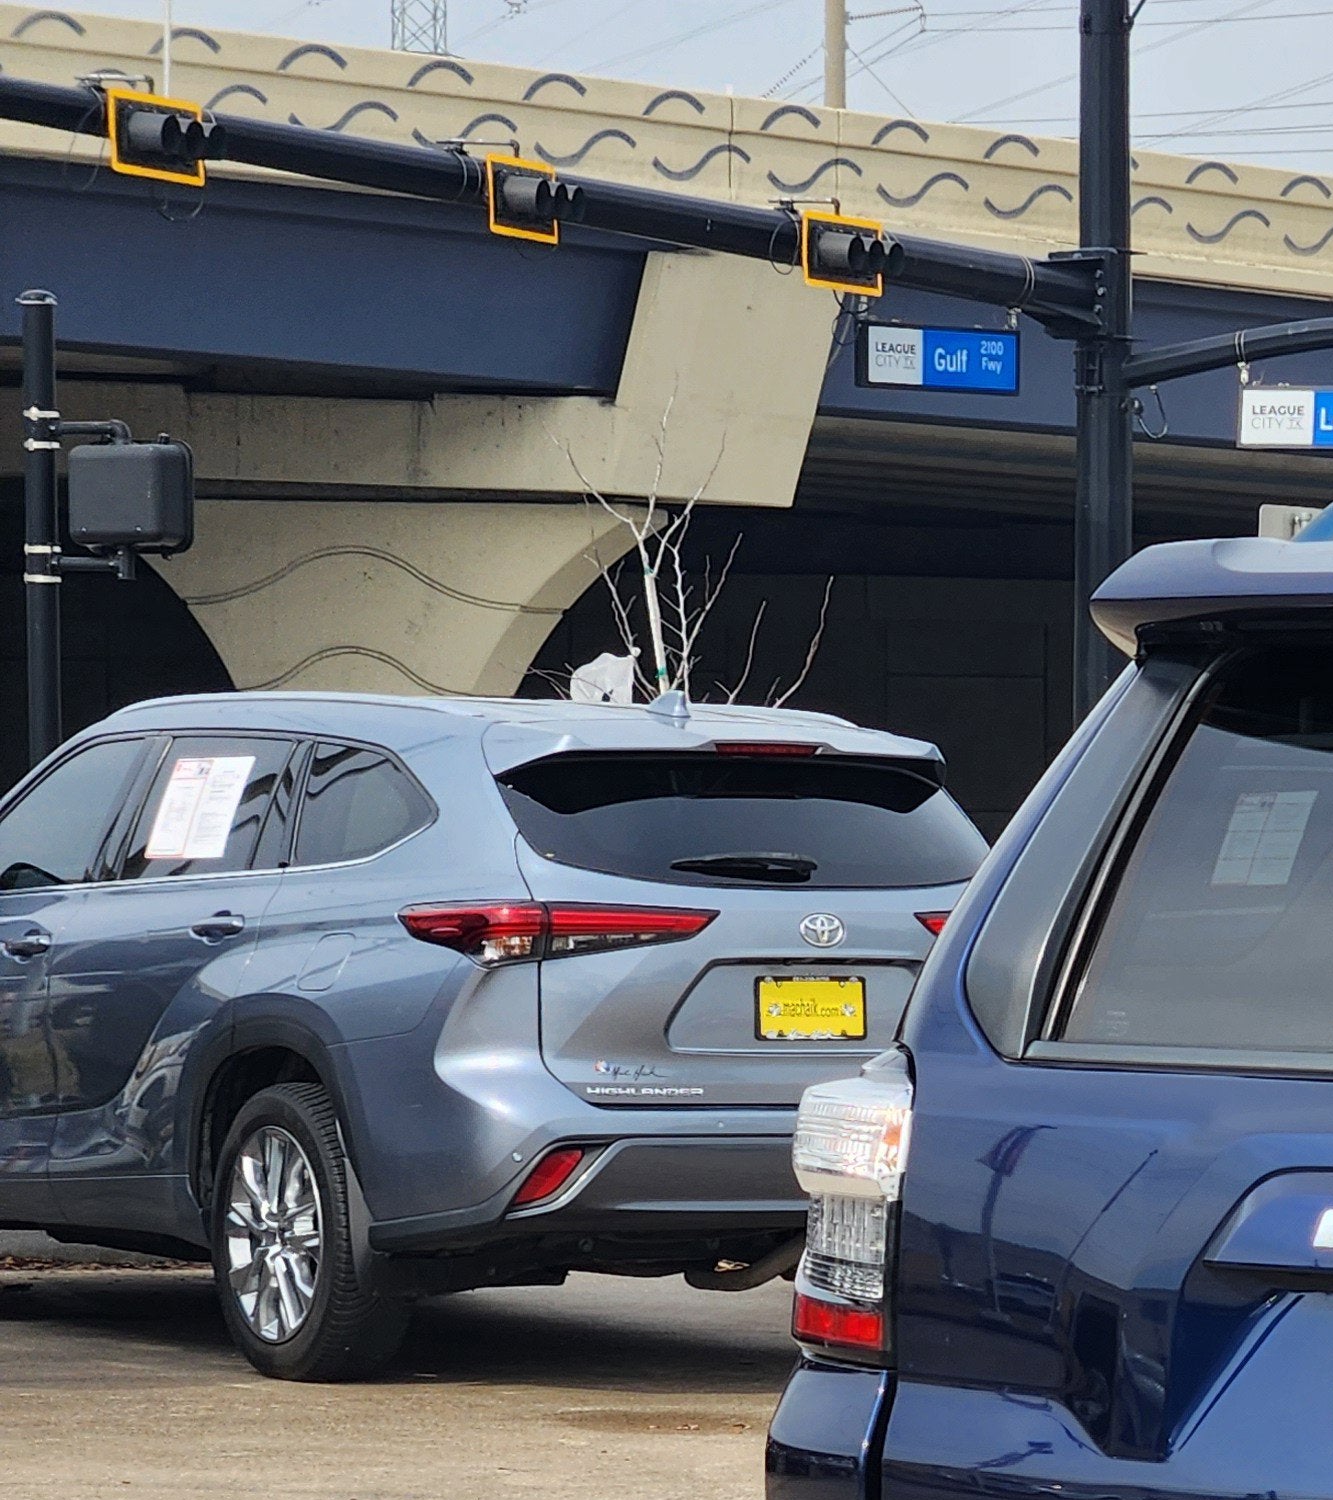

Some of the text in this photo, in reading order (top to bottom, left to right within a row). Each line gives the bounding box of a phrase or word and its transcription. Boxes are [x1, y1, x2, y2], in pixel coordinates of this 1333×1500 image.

[875, 341, 916, 355] LEAGUE
[980, 340, 1004, 356] 2100
[875, 355, 899, 368] CITY
[934, 347, 968, 373] Gulf
[981, 357, 1003, 375] Fwy
[1252, 405, 1304, 416] LEAGUE
[1251, 417, 1284, 430] CITY
[586, 1086, 705, 1097] HIGHLANDER
